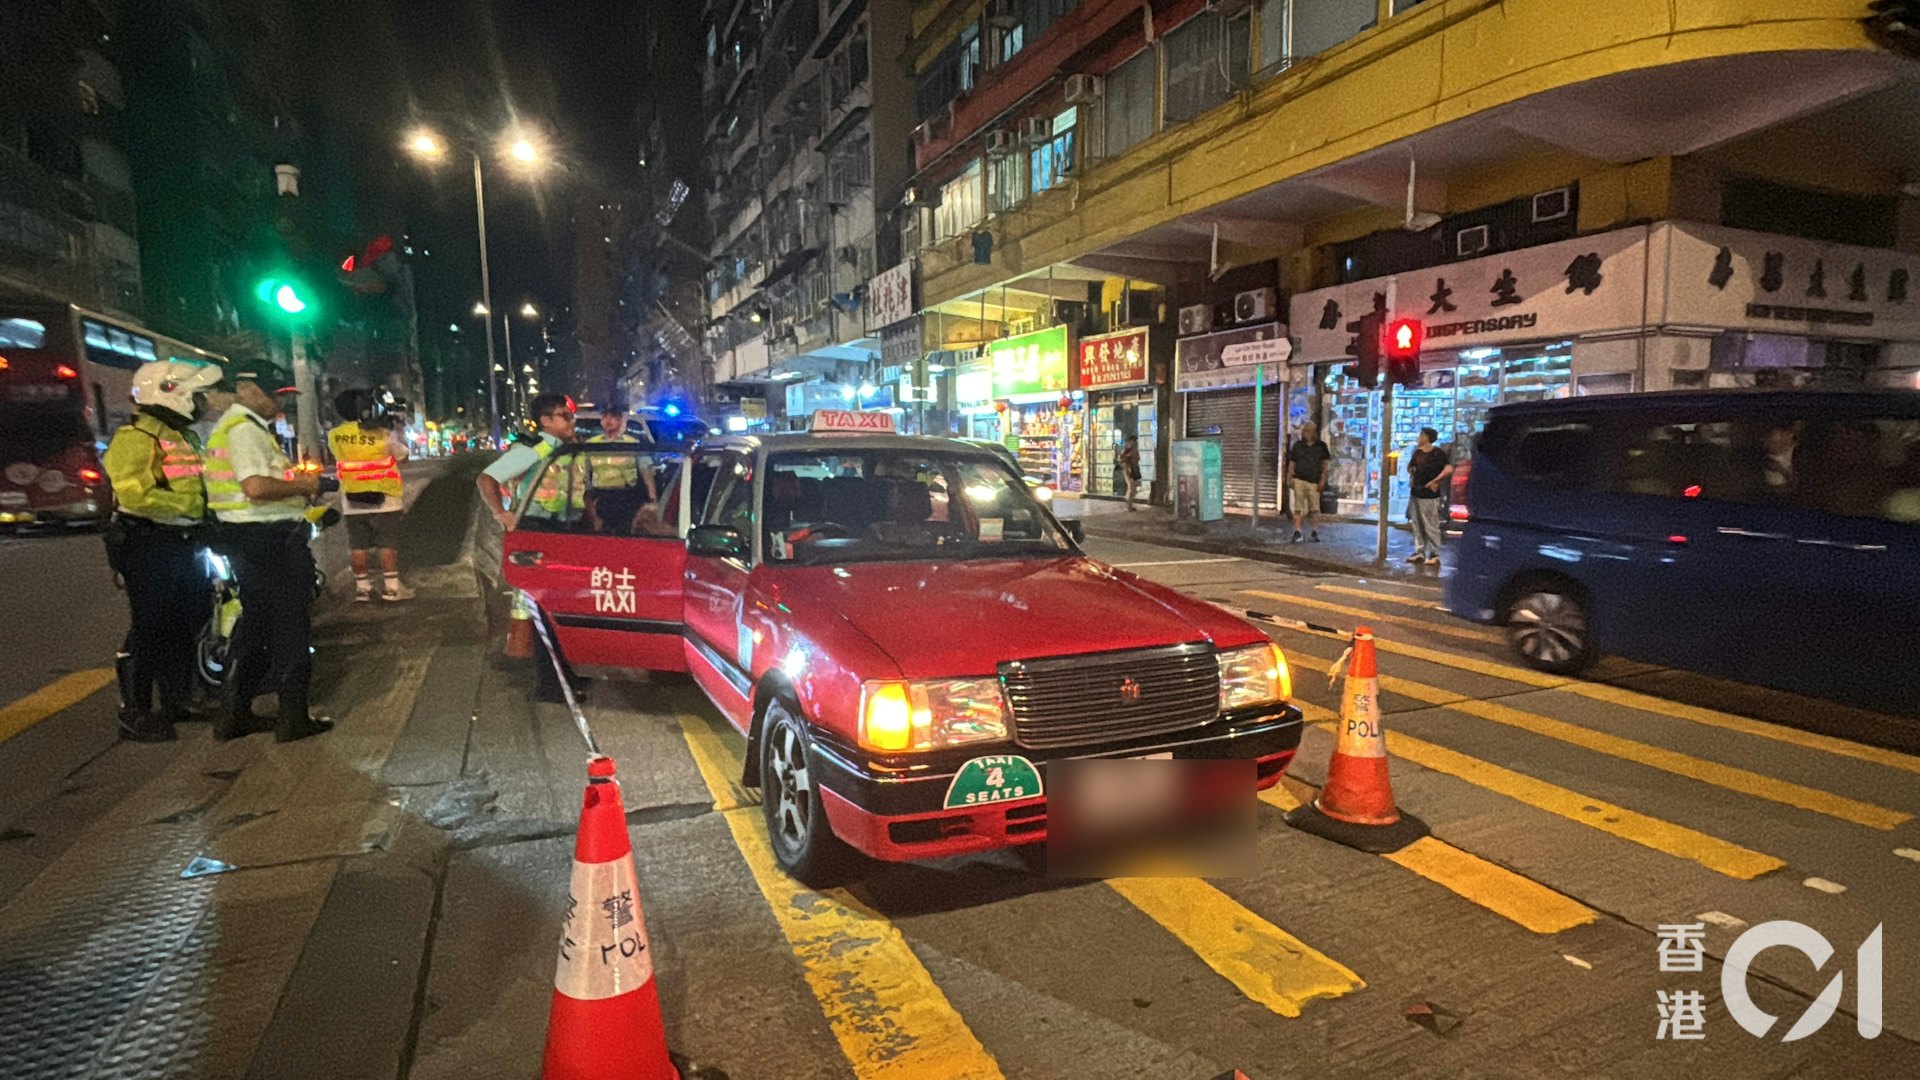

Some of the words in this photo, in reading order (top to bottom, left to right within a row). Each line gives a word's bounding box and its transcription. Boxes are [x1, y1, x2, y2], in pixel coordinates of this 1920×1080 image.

[1426, 312, 1537, 338] DISPENSARY
[822, 410, 891, 428] TAXI
[335, 434, 376, 446] PRESS
[591, 566, 636, 590] 的士
[591, 590, 636, 613] TAXI
[1346, 720, 1379, 738] POL
[973, 755, 1013, 770] TAXI
[986, 768, 1005, 788] 4
[965, 786, 1024, 804] SEATS
